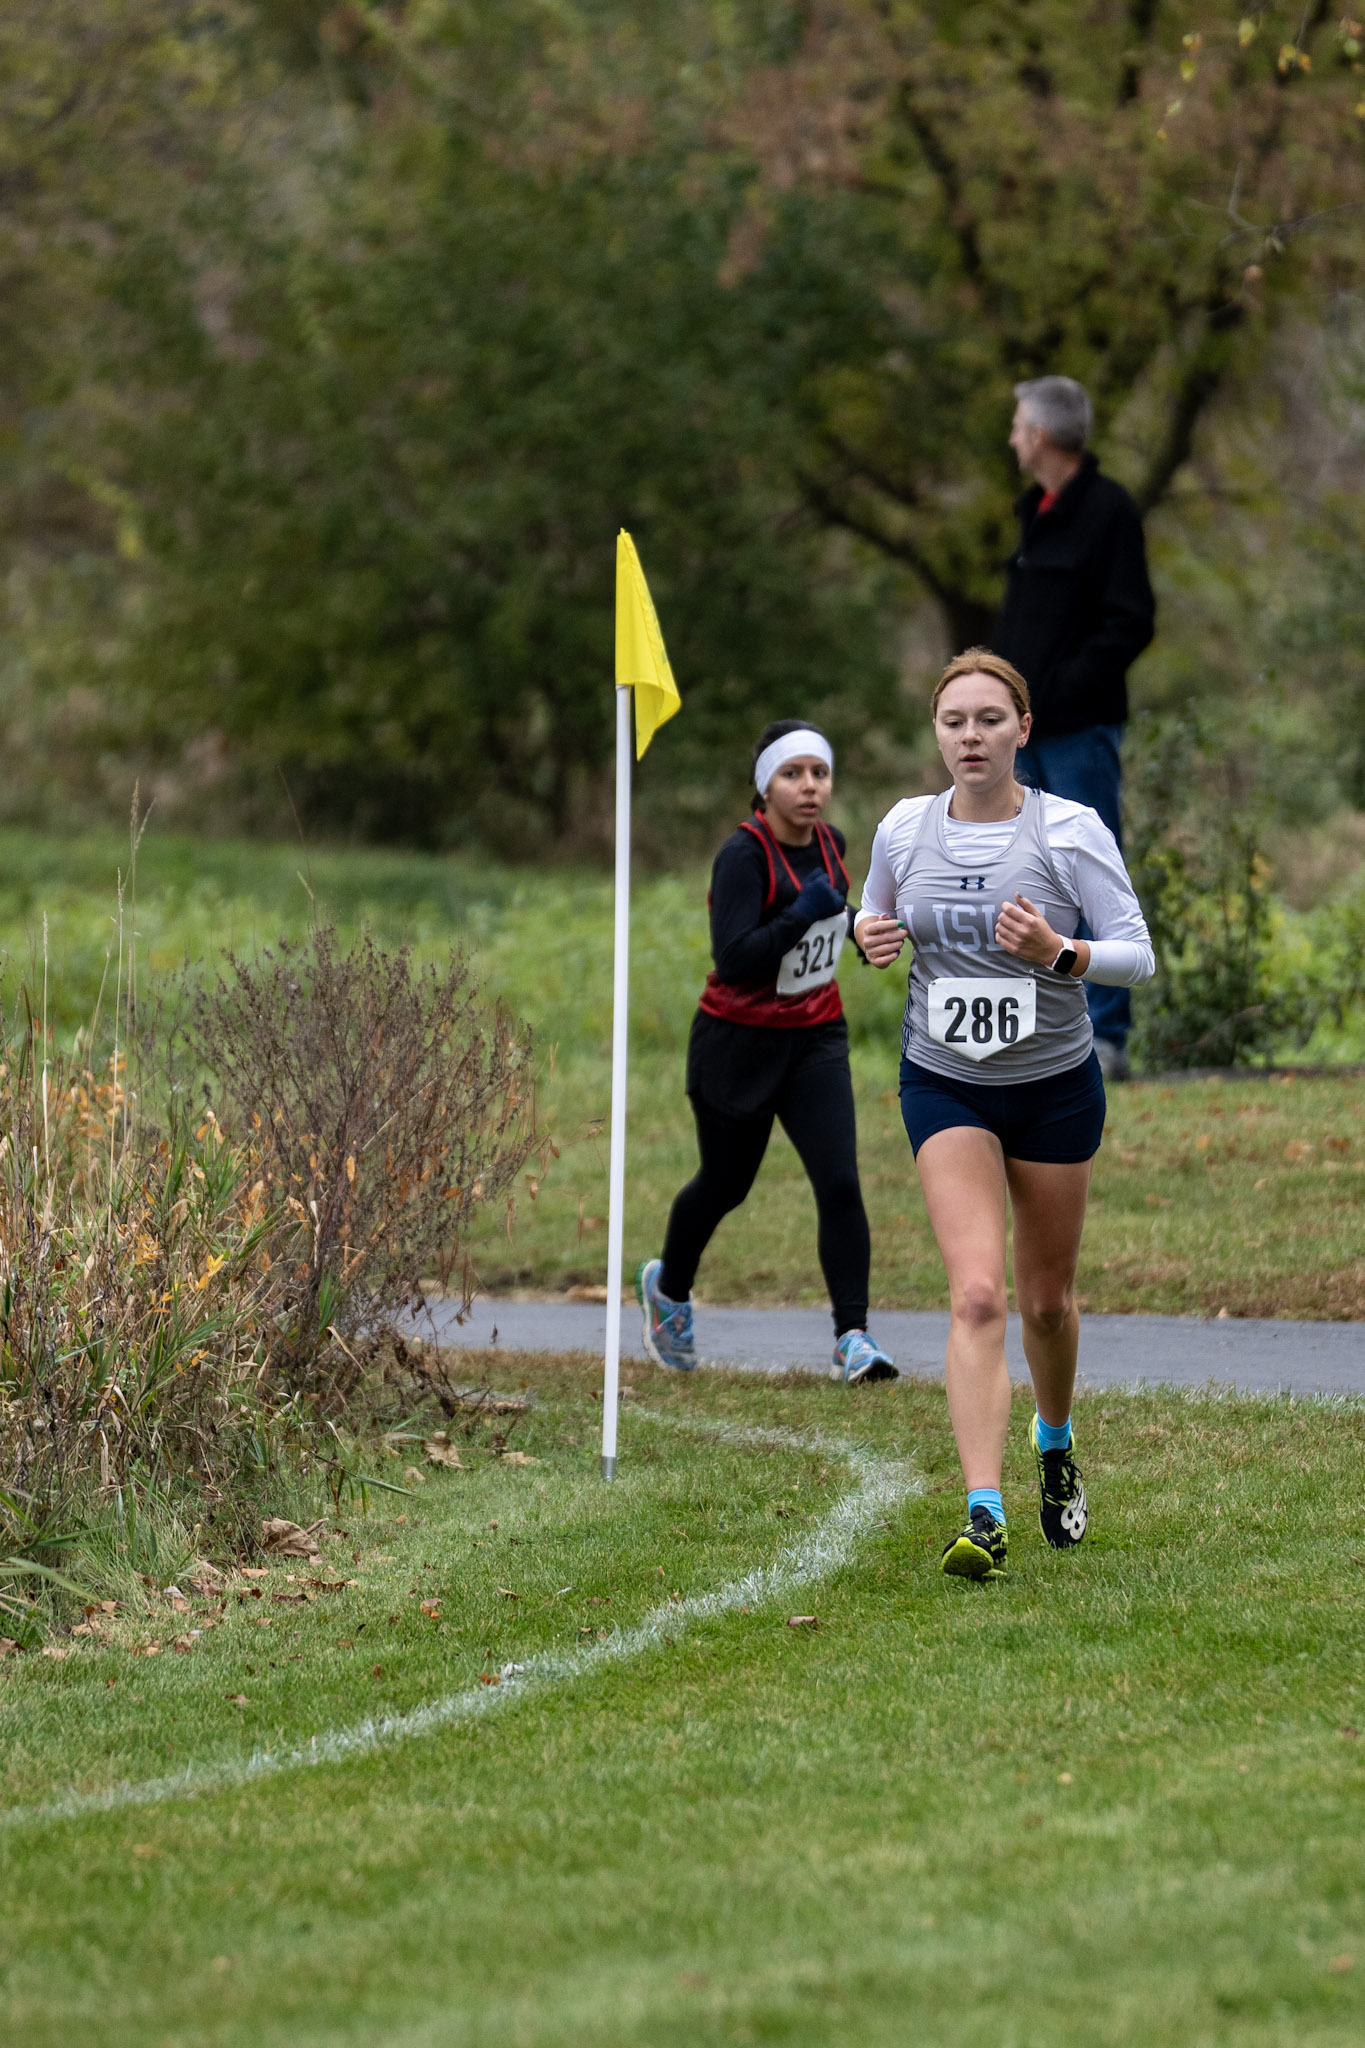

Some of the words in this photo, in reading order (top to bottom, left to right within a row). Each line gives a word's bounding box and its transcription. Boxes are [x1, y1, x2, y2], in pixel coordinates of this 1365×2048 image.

[904, 904, 1045, 953] LISL
[793, 930, 836, 978] 321
[944, 996, 1019, 1044] 286
